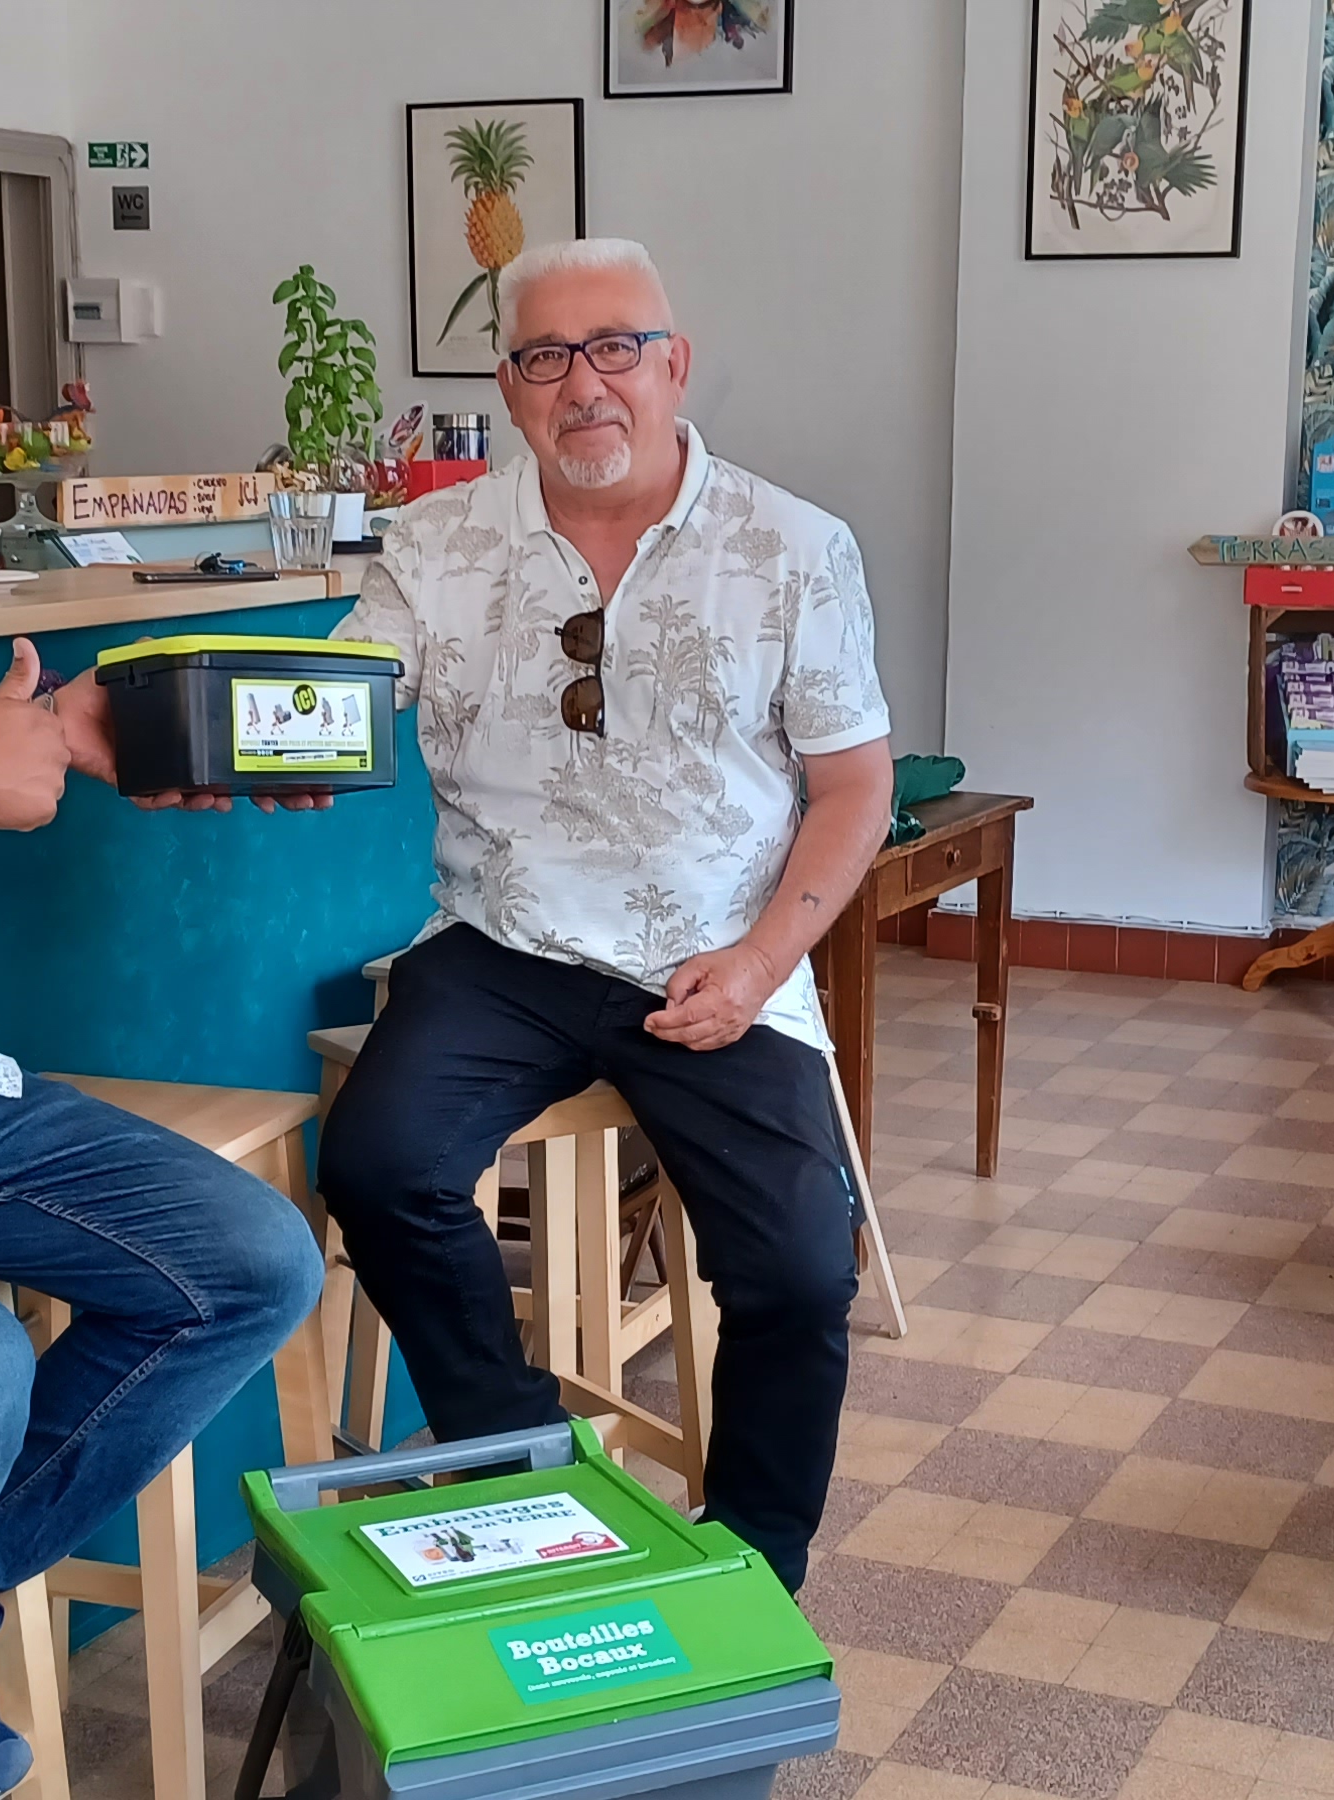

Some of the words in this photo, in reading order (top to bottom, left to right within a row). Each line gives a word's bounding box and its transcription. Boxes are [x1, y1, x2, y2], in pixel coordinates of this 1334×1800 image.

[117, 193, 144, 210] WC
[294, 687, 316, 712] ICI
[374, 1499, 565, 1537] Emballages
[470, 1520, 498, 1530] en
[498, 1509, 577, 1525] VERRE
[506, 1619, 655, 1660] Bouteilles
[537, 1643, 648, 1676] Bocaux
